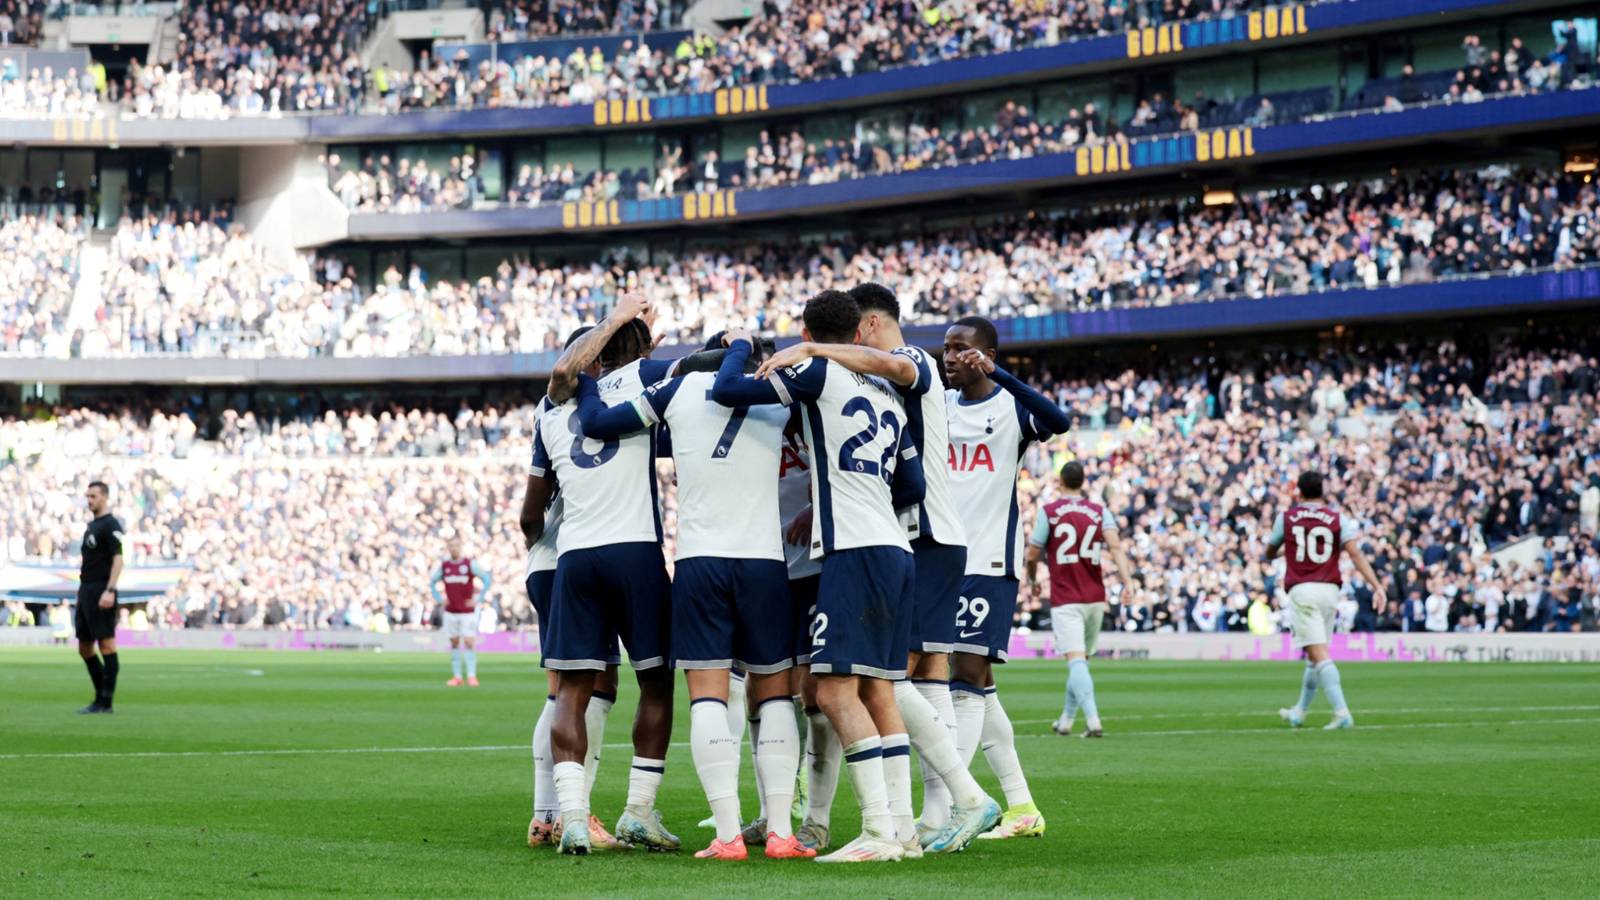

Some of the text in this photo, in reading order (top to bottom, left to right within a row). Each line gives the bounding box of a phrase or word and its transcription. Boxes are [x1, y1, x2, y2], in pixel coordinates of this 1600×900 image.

[1127, 23, 1183, 58] GOAL
[1248, 6, 1308, 41] GOAL
[594, 97, 652, 125] GOAL
[715, 85, 769, 115] GOAL
[1076, 143, 1131, 176] GOAL
[1196, 128, 1255, 161] GOAL
[563, 200, 621, 228] GOAL
[683, 191, 737, 220] GOAL
[705, 389, 750, 458] 7
[839, 396, 899, 483] 22
[1054, 522, 1101, 566] 24
[1292, 526, 1334, 564] 10
[955, 596, 990, 628] 29
